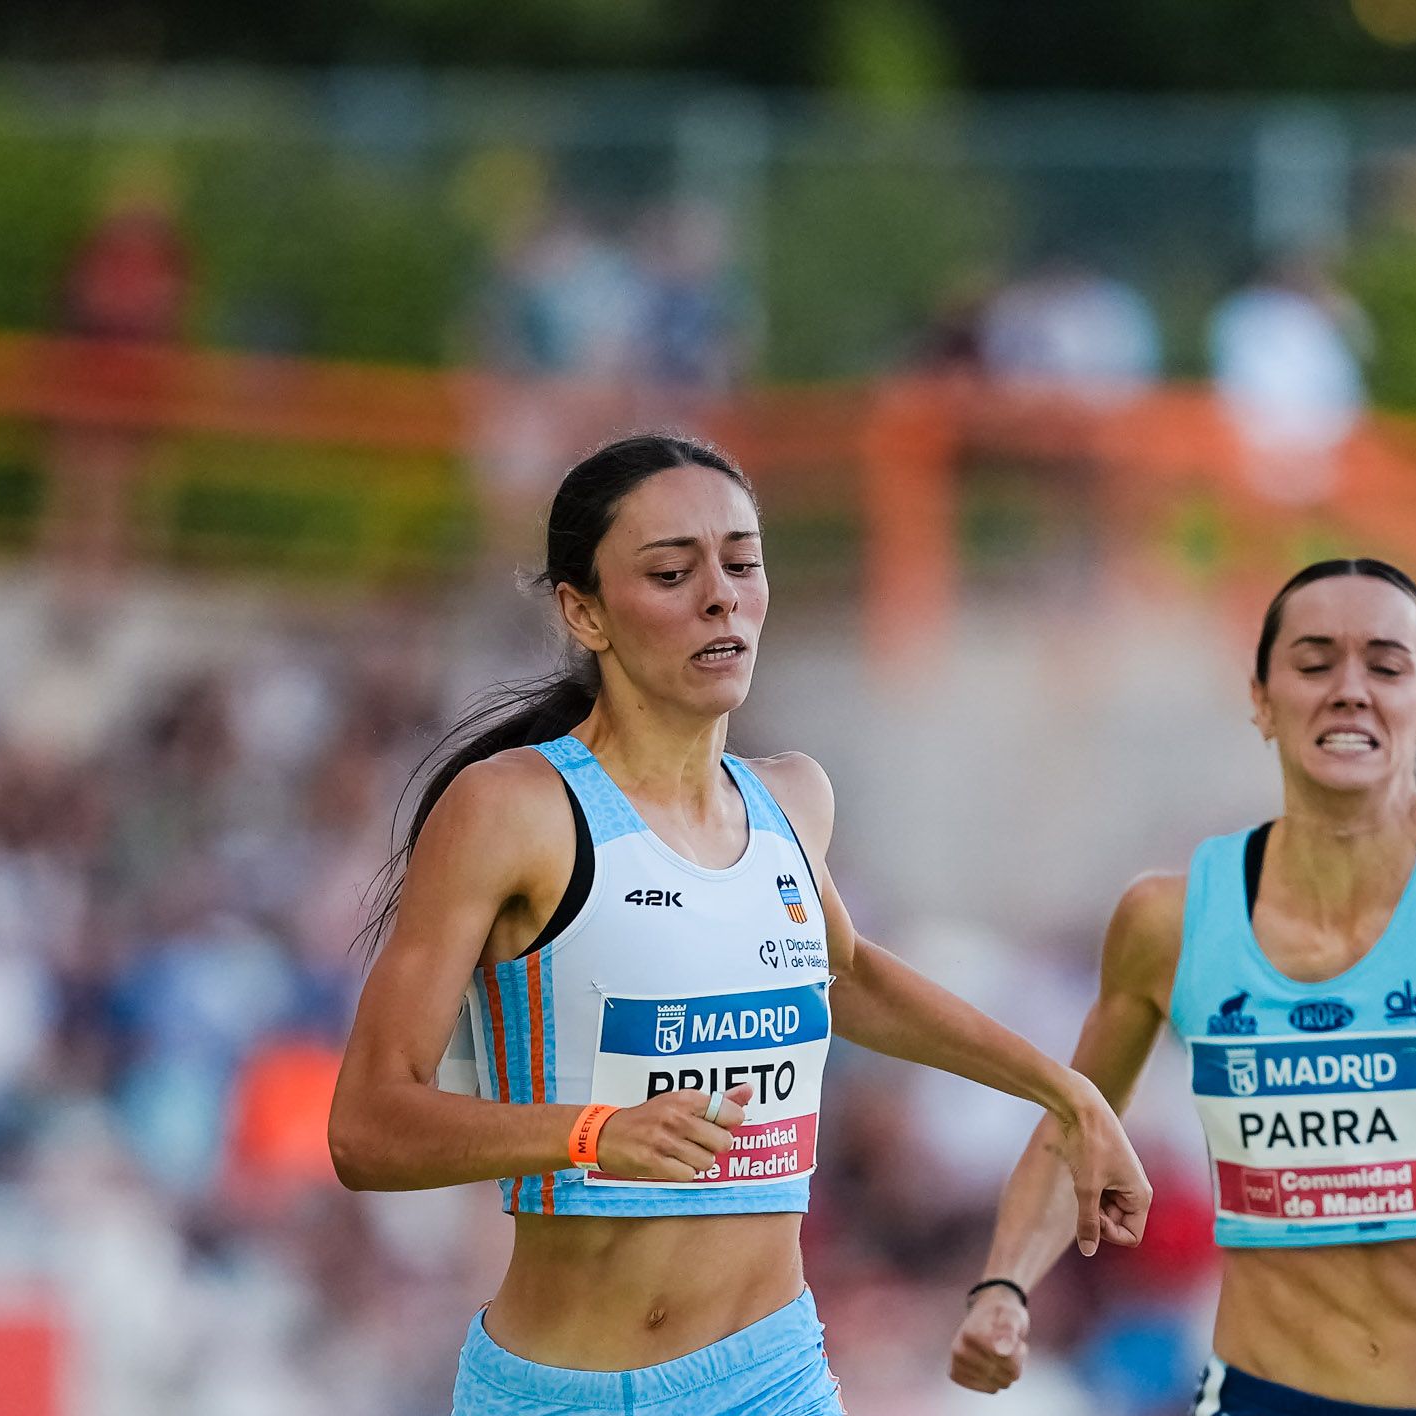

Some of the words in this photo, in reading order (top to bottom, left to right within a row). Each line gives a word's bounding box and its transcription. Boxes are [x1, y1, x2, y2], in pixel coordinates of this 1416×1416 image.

[624, 889, 683, 908] 42K
[791, 956, 804, 968] de
[691, 1005, 800, 1042] MADRID
[1265, 1053, 1397, 1090] MADRID
[578, 1106, 605, 1154] MEETING
[732, 1123, 797, 1151] munidad
[1239, 1106, 1399, 1149] PARRA
[728, 1150, 798, 1178] Madrid
[1280, 1164, 1413, 1192] Comunidad
[1283, 1194, 1317, 1218] de
[1321, 1189, 1414, 1216] Madrid
